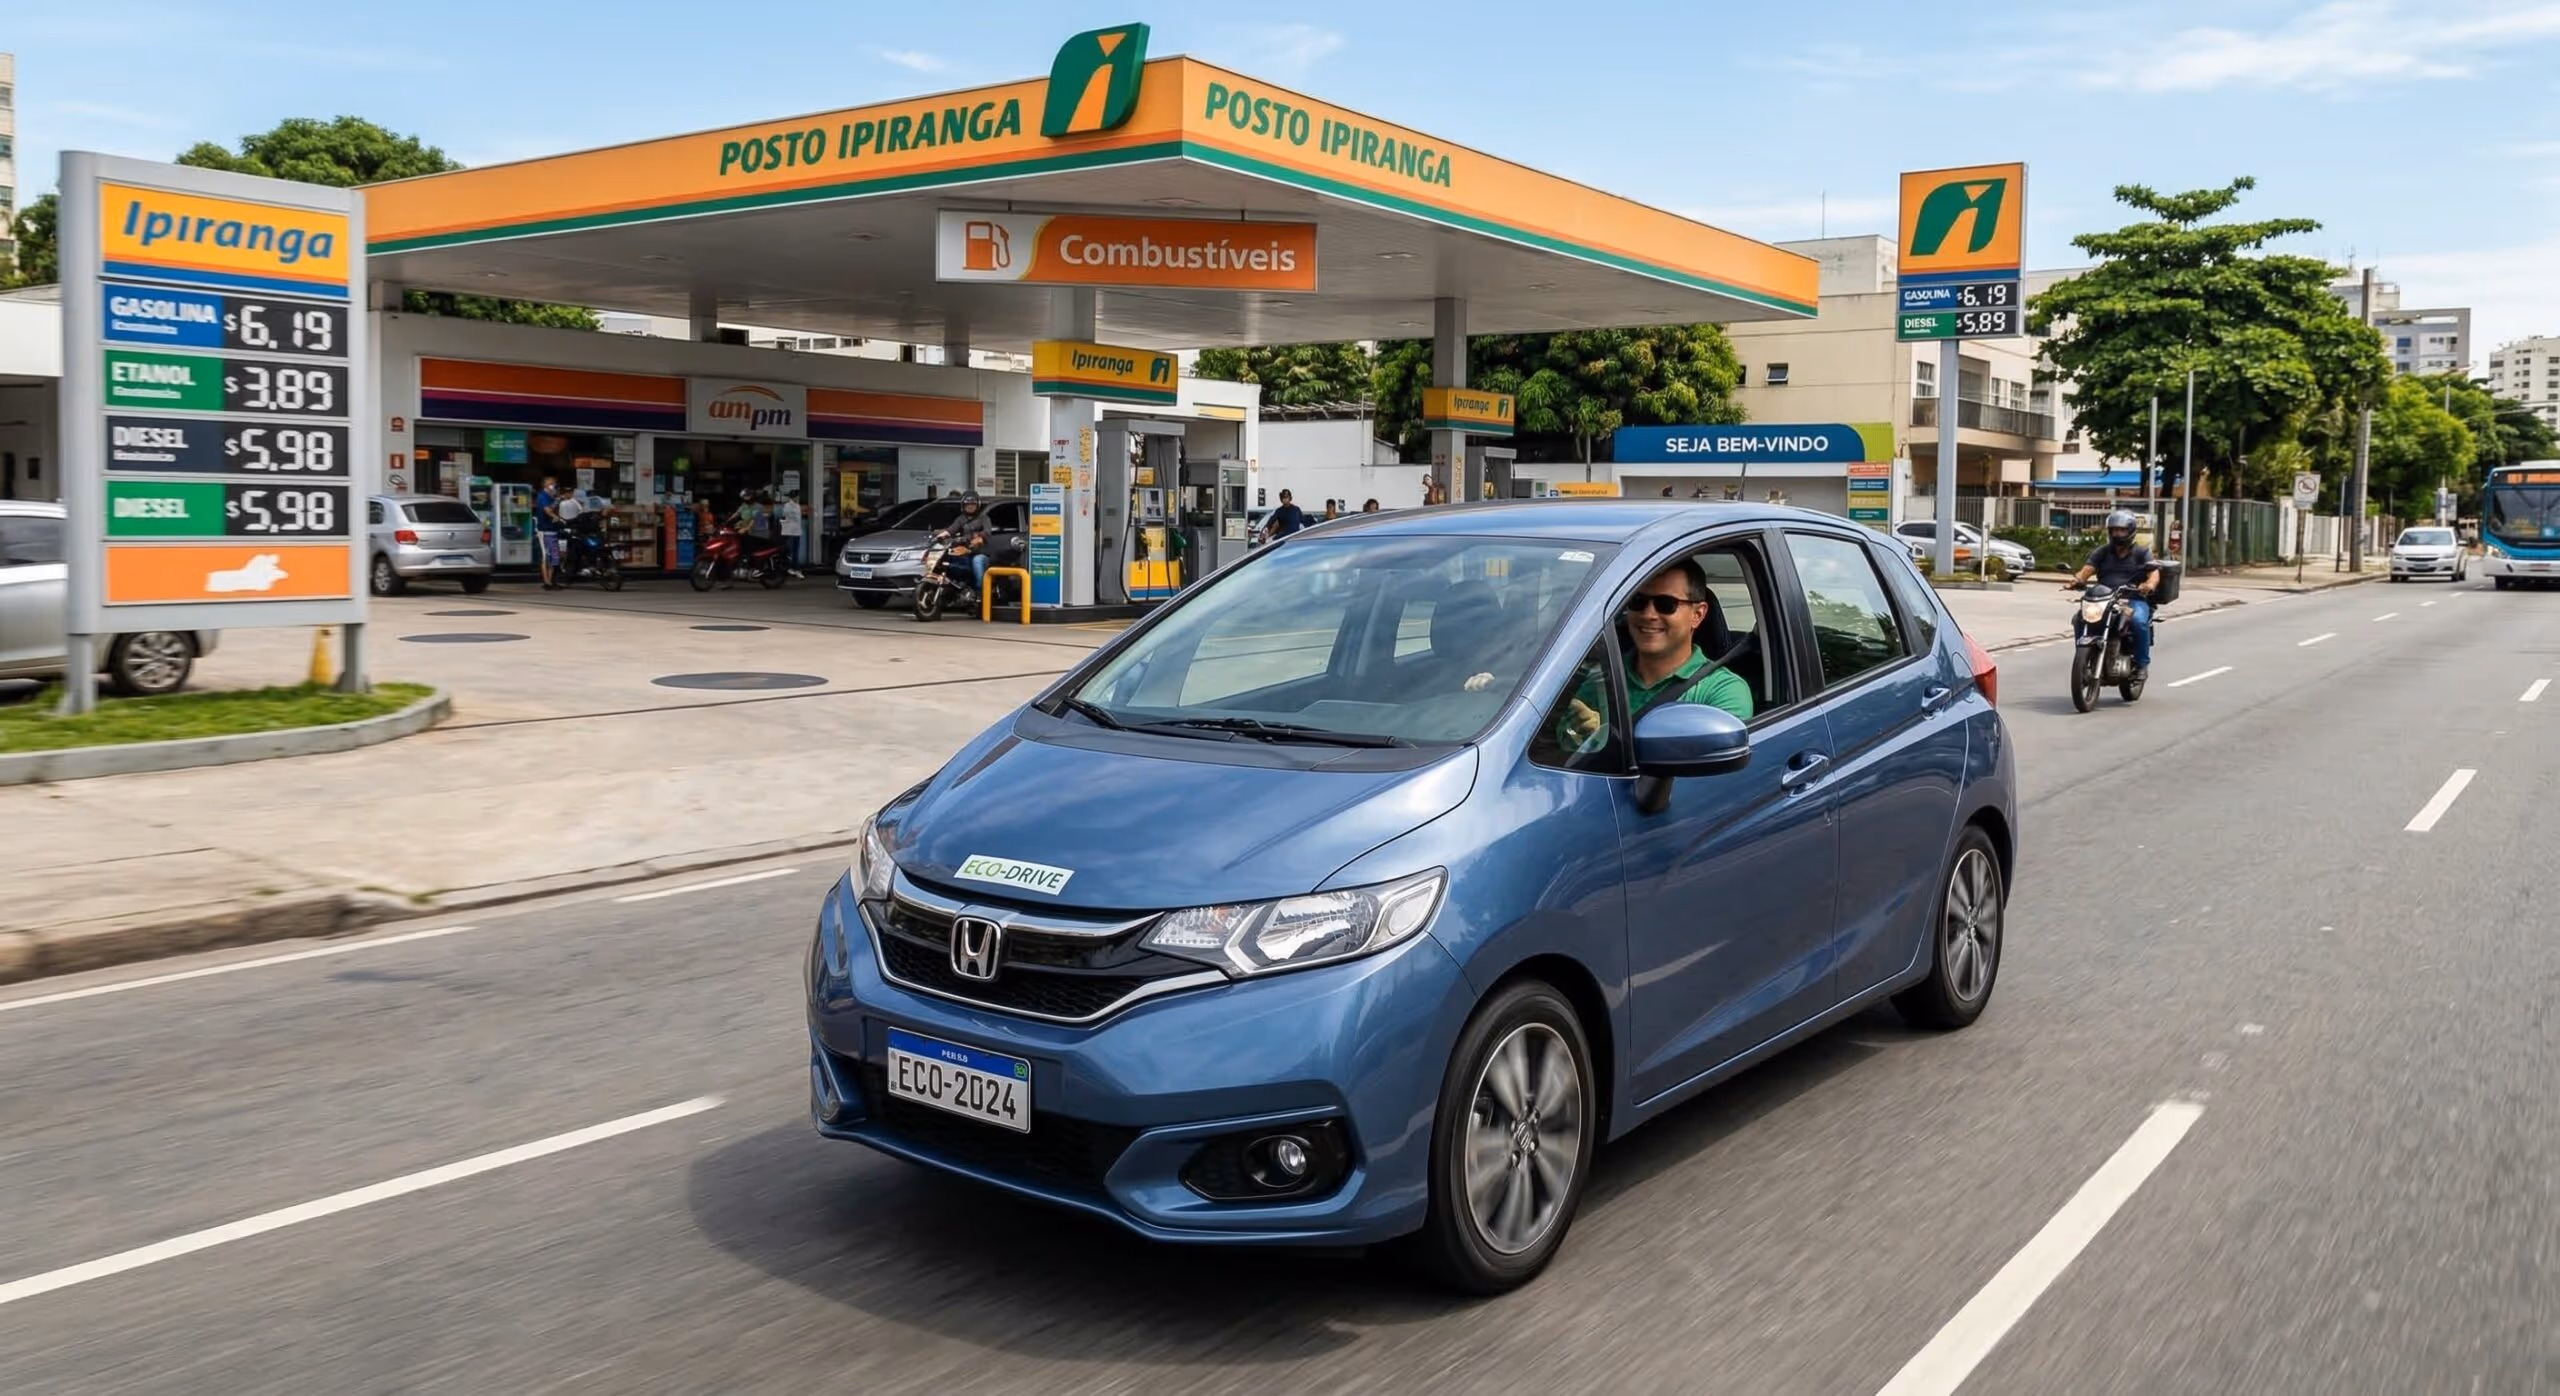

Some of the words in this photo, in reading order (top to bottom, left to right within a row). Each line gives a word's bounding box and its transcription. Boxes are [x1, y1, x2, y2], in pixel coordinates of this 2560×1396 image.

[720, 128, 826, 176] POSTO
[838, 98, 1021, 160] IPIRANGA
[1205, 82, 1310, 146] POSTO
[1320, 119, 1451, 187] IPIRANGA
[123, 200, 334, 264] Ipiranga
[1059, 233, 1296, 272] Combustíveis
[110, 296, 218, 324] GASOLINA
[111, 361, 197, 386] ETANOL
[1072, 349, 1134, 376] Ipiranga
[708, 399, 792, 430] ampm
[112, 426, 189, 448] DIESEL
[1665, 437, 1711, 453] SEJA
[1717, 435, 1829, 452] BEM-VINDO
[112, 497, 190, 518] DIESEL
[963, 859, 1064, 889] ECO-DRIVE
[899, 1055, 1016, 1120] ECO-2024
